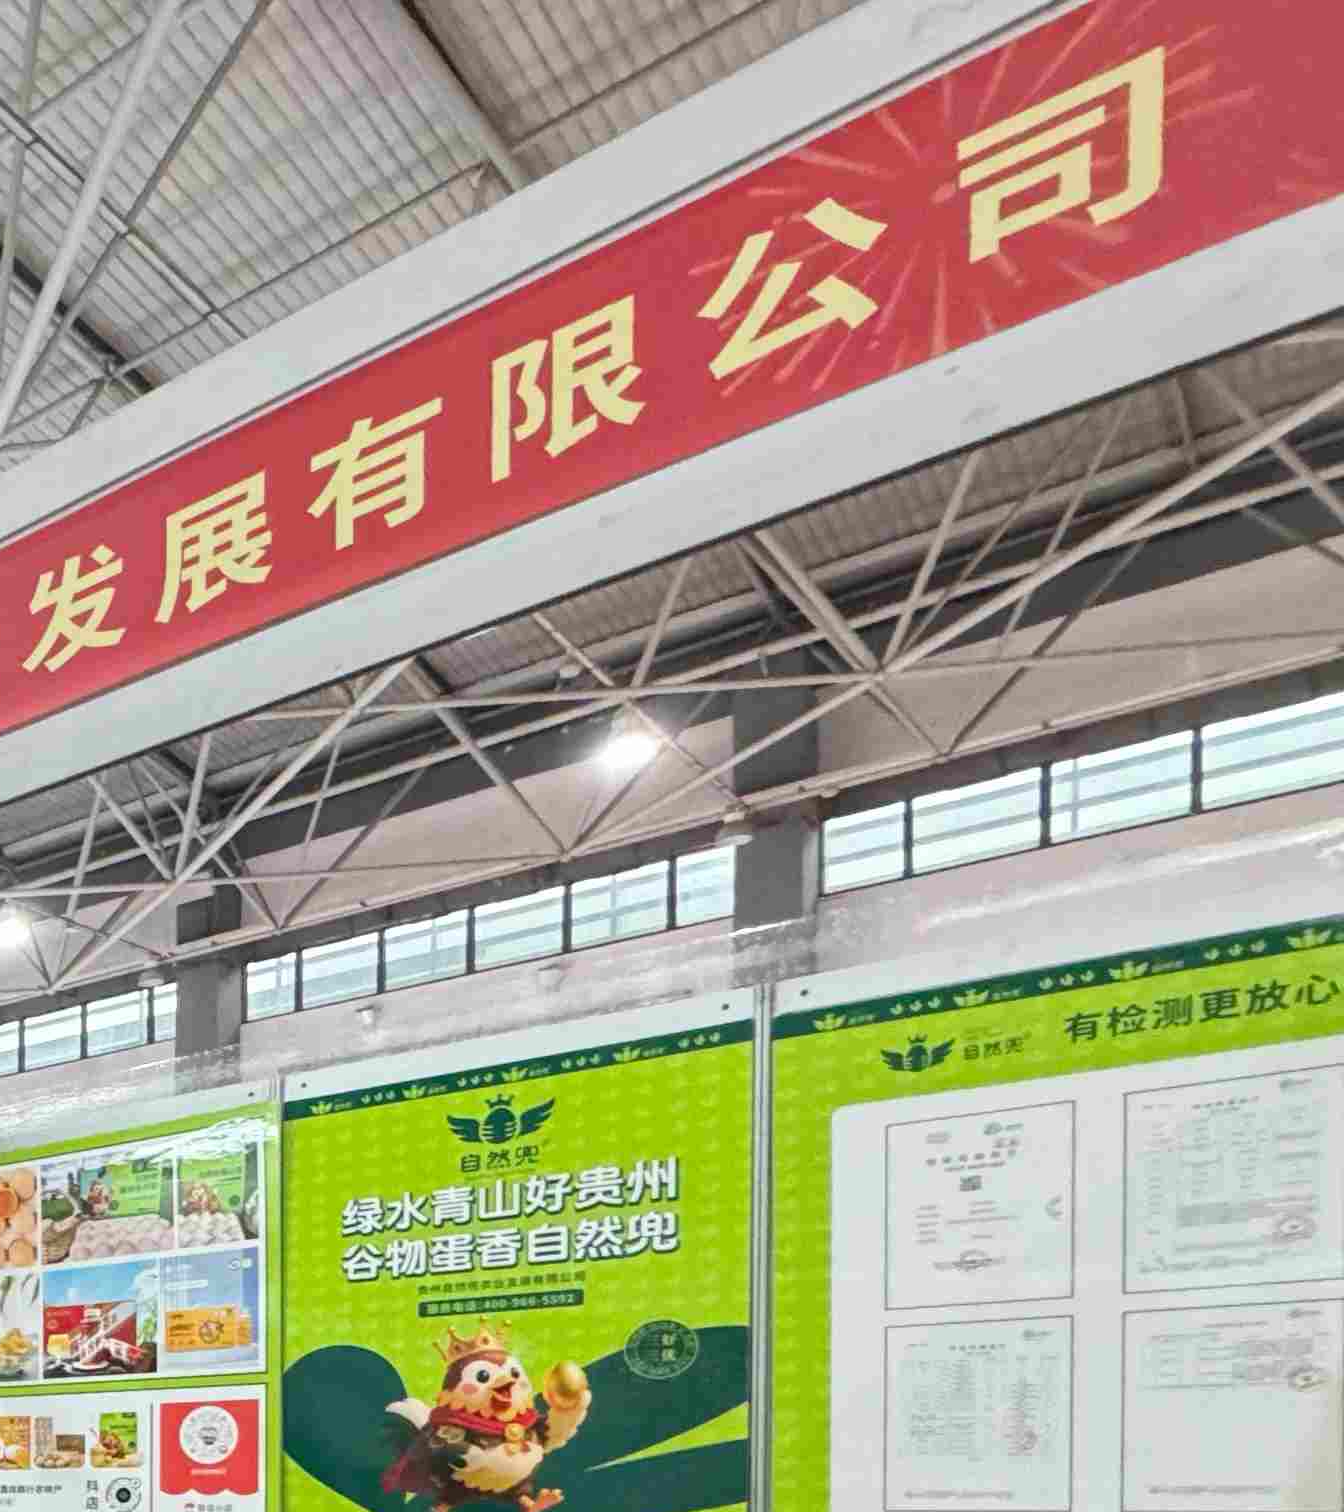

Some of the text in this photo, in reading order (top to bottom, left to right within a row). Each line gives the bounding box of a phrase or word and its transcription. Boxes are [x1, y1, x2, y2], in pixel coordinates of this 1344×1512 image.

[1064, 974, 1340, 1046] 有检测更放心
[460, 1143, 540, 1173] 自然兜
[341, 1156, 679, 1237] 绿水青山好贵州
[341, 1210, 679, 1284] 谷物蛋香自然兜
